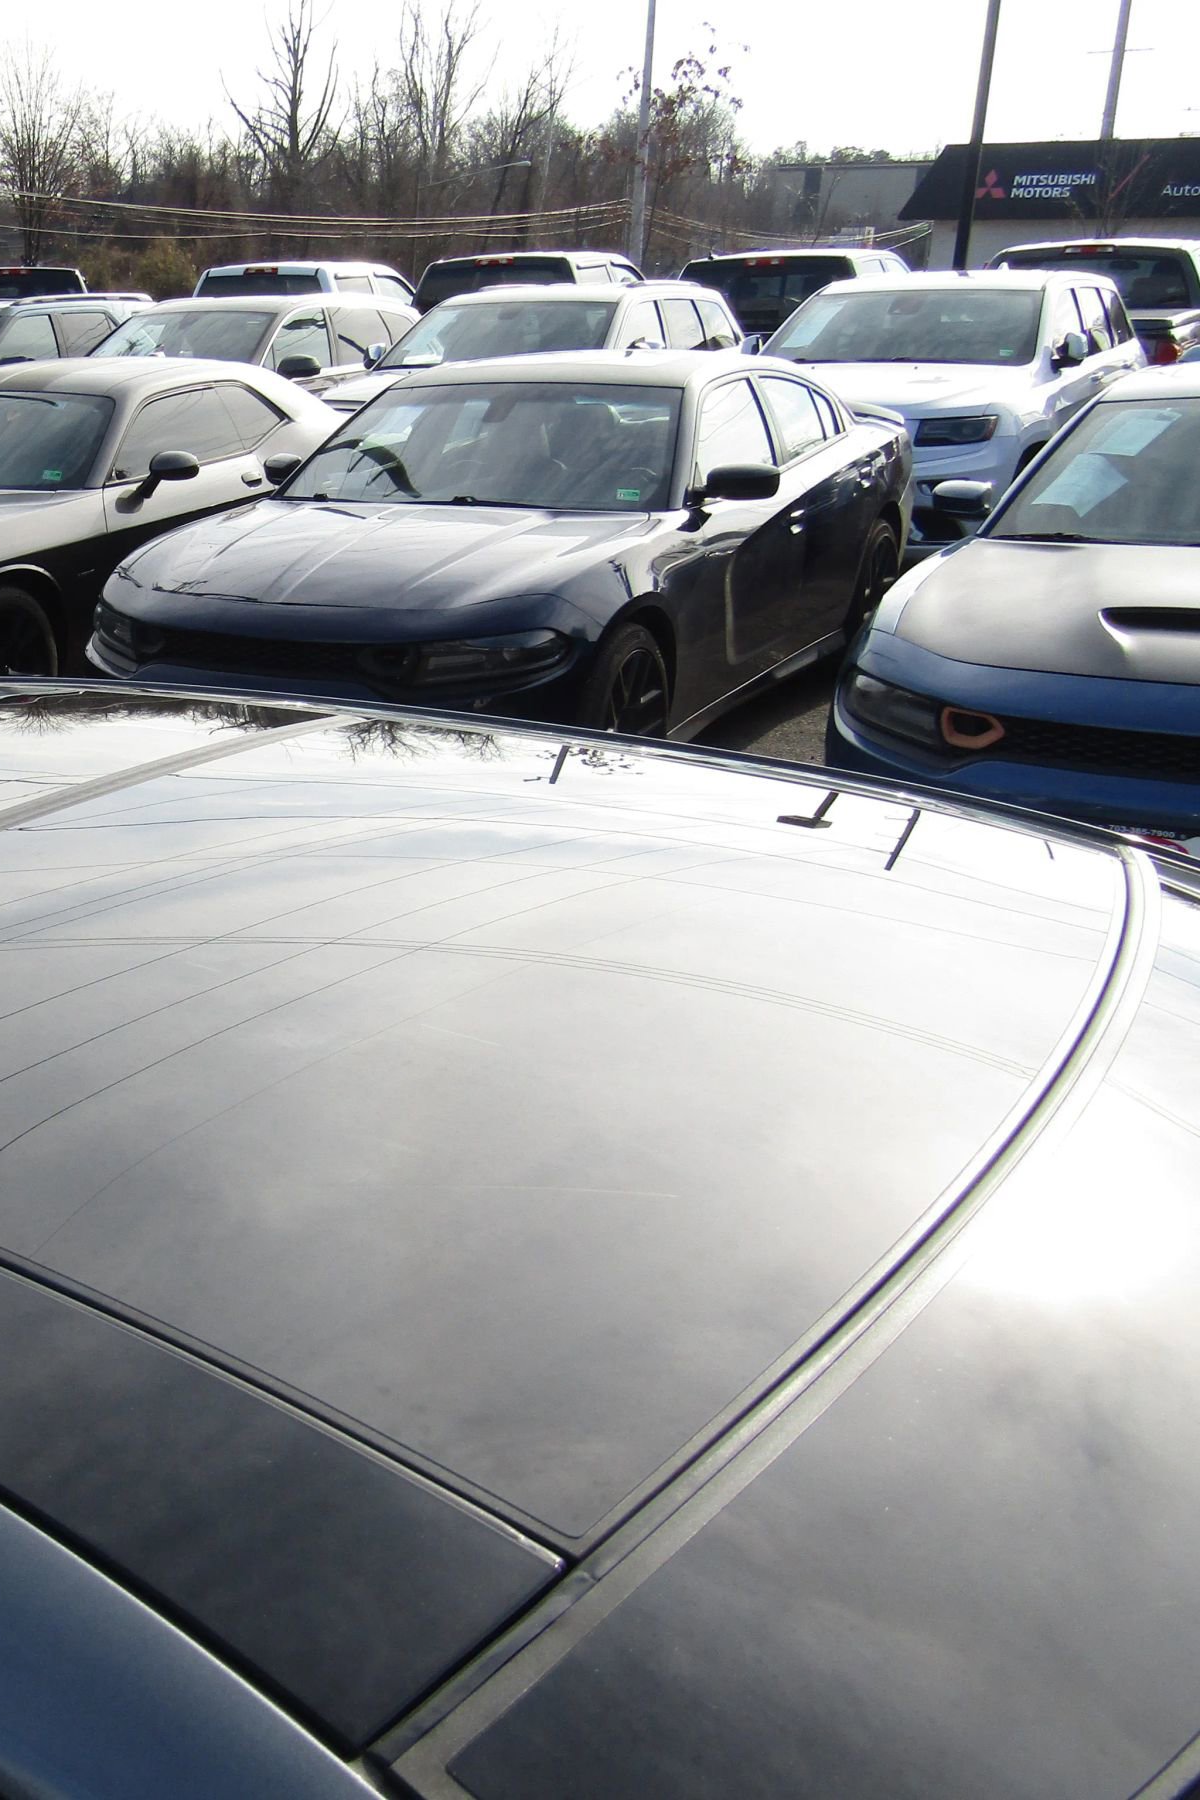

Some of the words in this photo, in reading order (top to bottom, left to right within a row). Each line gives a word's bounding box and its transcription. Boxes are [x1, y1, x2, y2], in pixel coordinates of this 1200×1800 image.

[1013, 174, 1096, 186] MITSUBISHI
[1010, 187, 1071, 198] MOTORS
[1161, 184, 1200, 197] Auto
